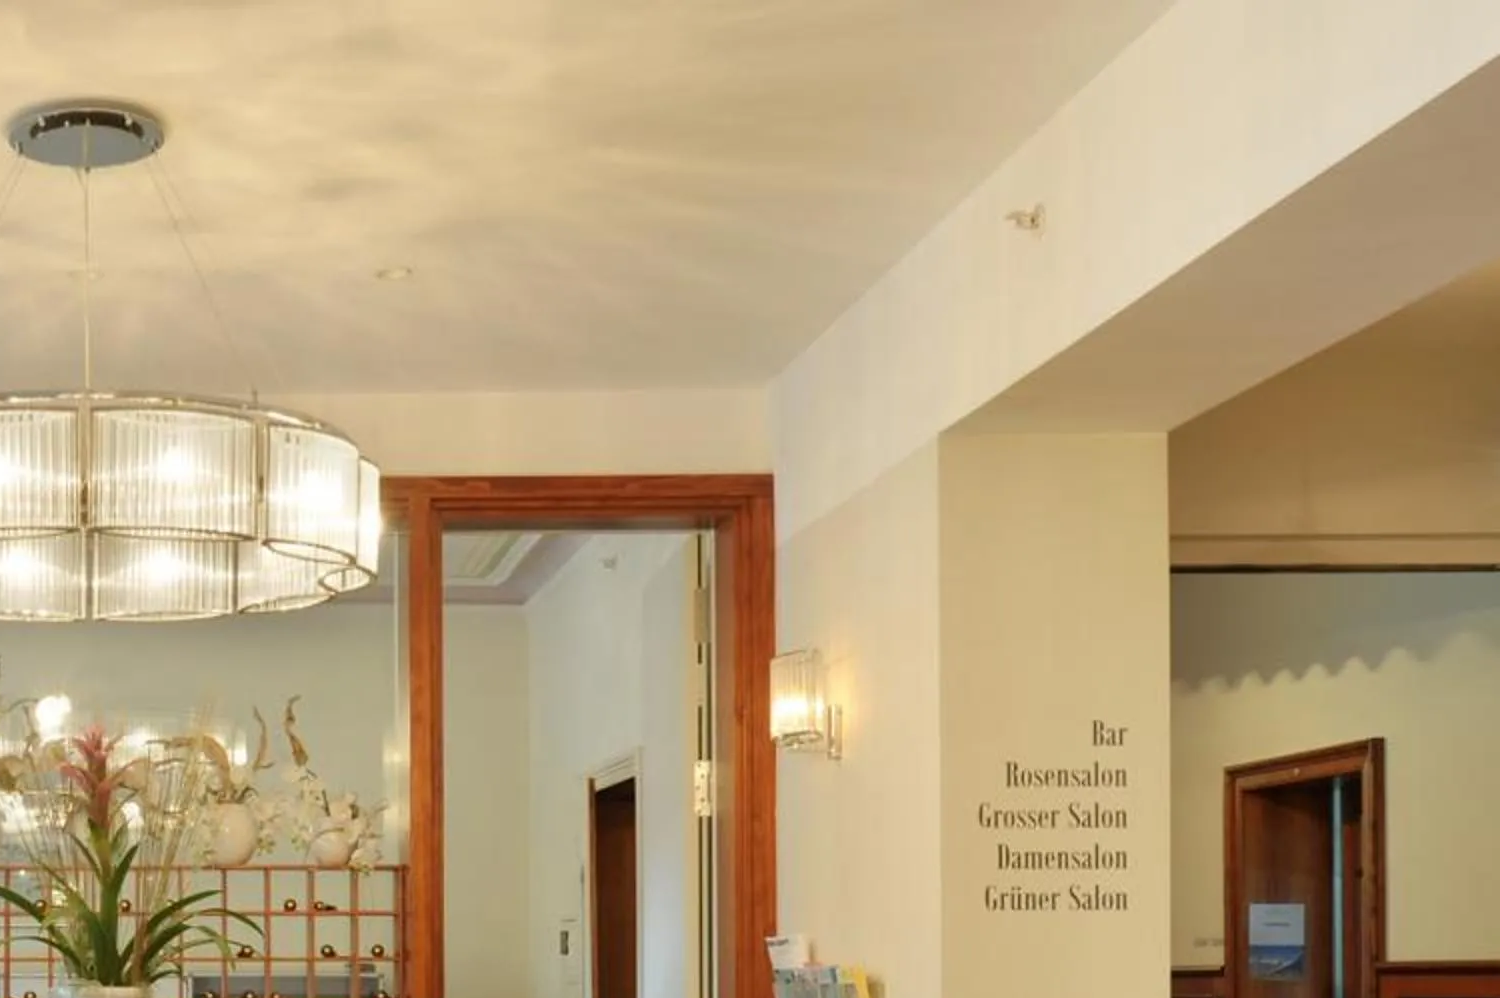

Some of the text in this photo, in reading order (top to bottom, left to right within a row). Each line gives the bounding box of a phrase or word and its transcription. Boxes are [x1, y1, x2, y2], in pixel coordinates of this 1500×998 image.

[1093, 719, 1128, 747] Bar
[1005, 761, 1128, 788] Rosensalon
[978, 802, 1128, 829] Grosser Salon
[997, 843, 1128, 870] Damensalon
[985, 885, 1128, 911] Grüner Salon
